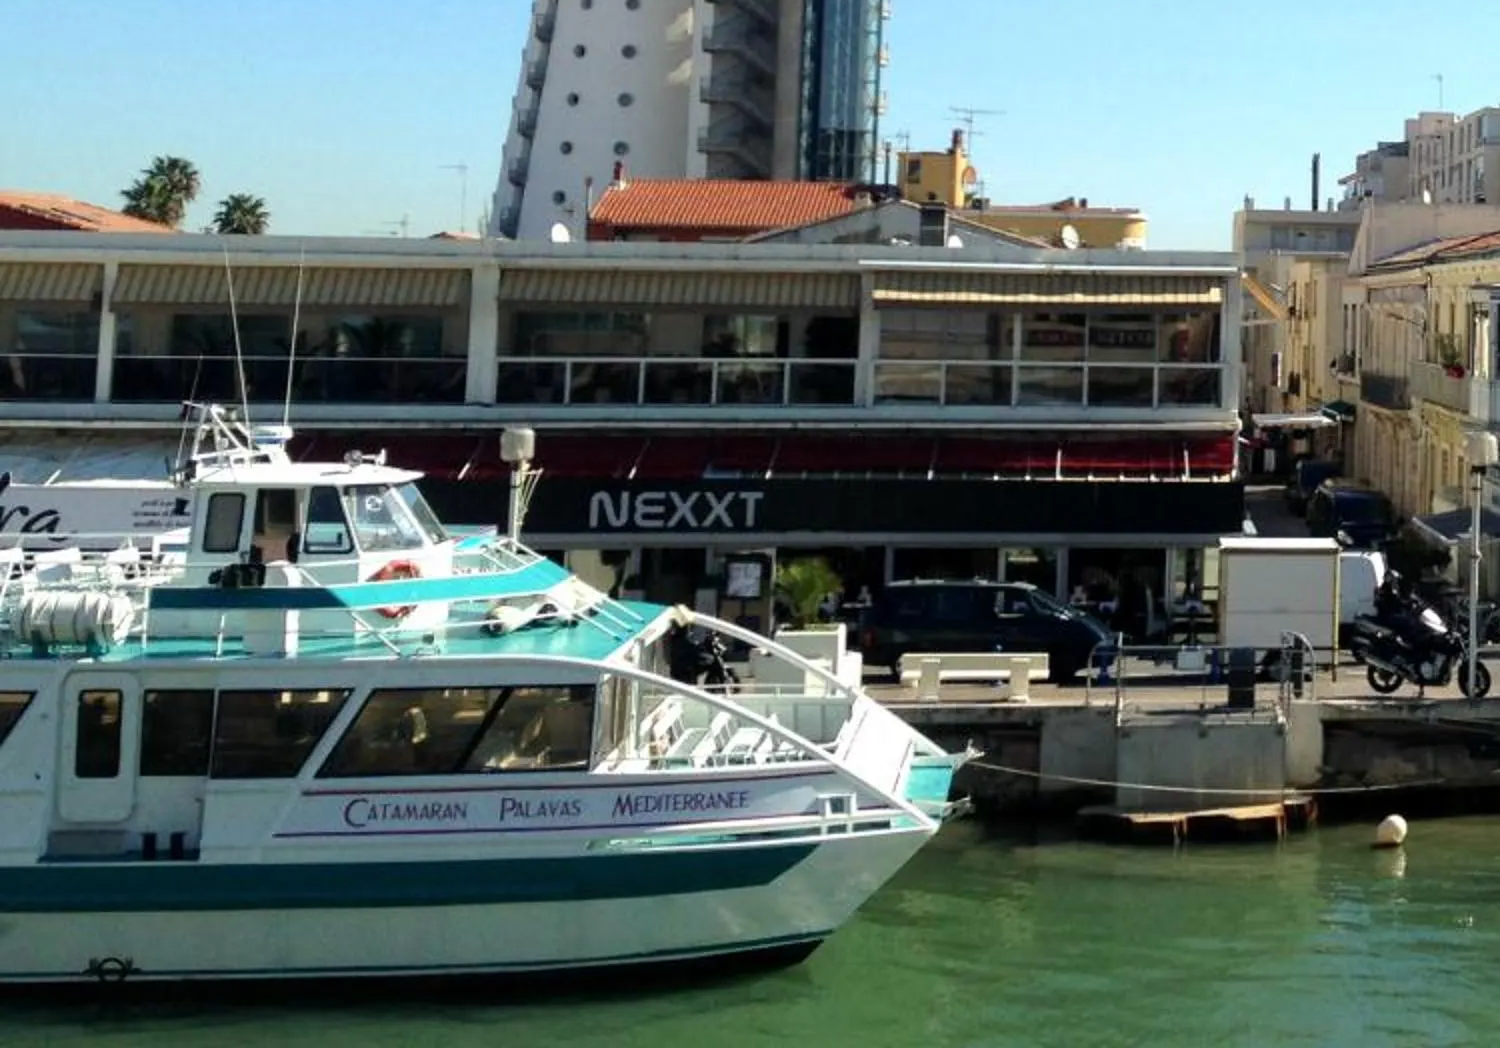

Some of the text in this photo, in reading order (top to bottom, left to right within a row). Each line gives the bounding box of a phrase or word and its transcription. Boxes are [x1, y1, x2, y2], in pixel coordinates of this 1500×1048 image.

[588, 490, 765, 529] NEXXT
[343, 797, 468, 829] CATAMARAN
[499, 796, 582, 822] PALAVAS
